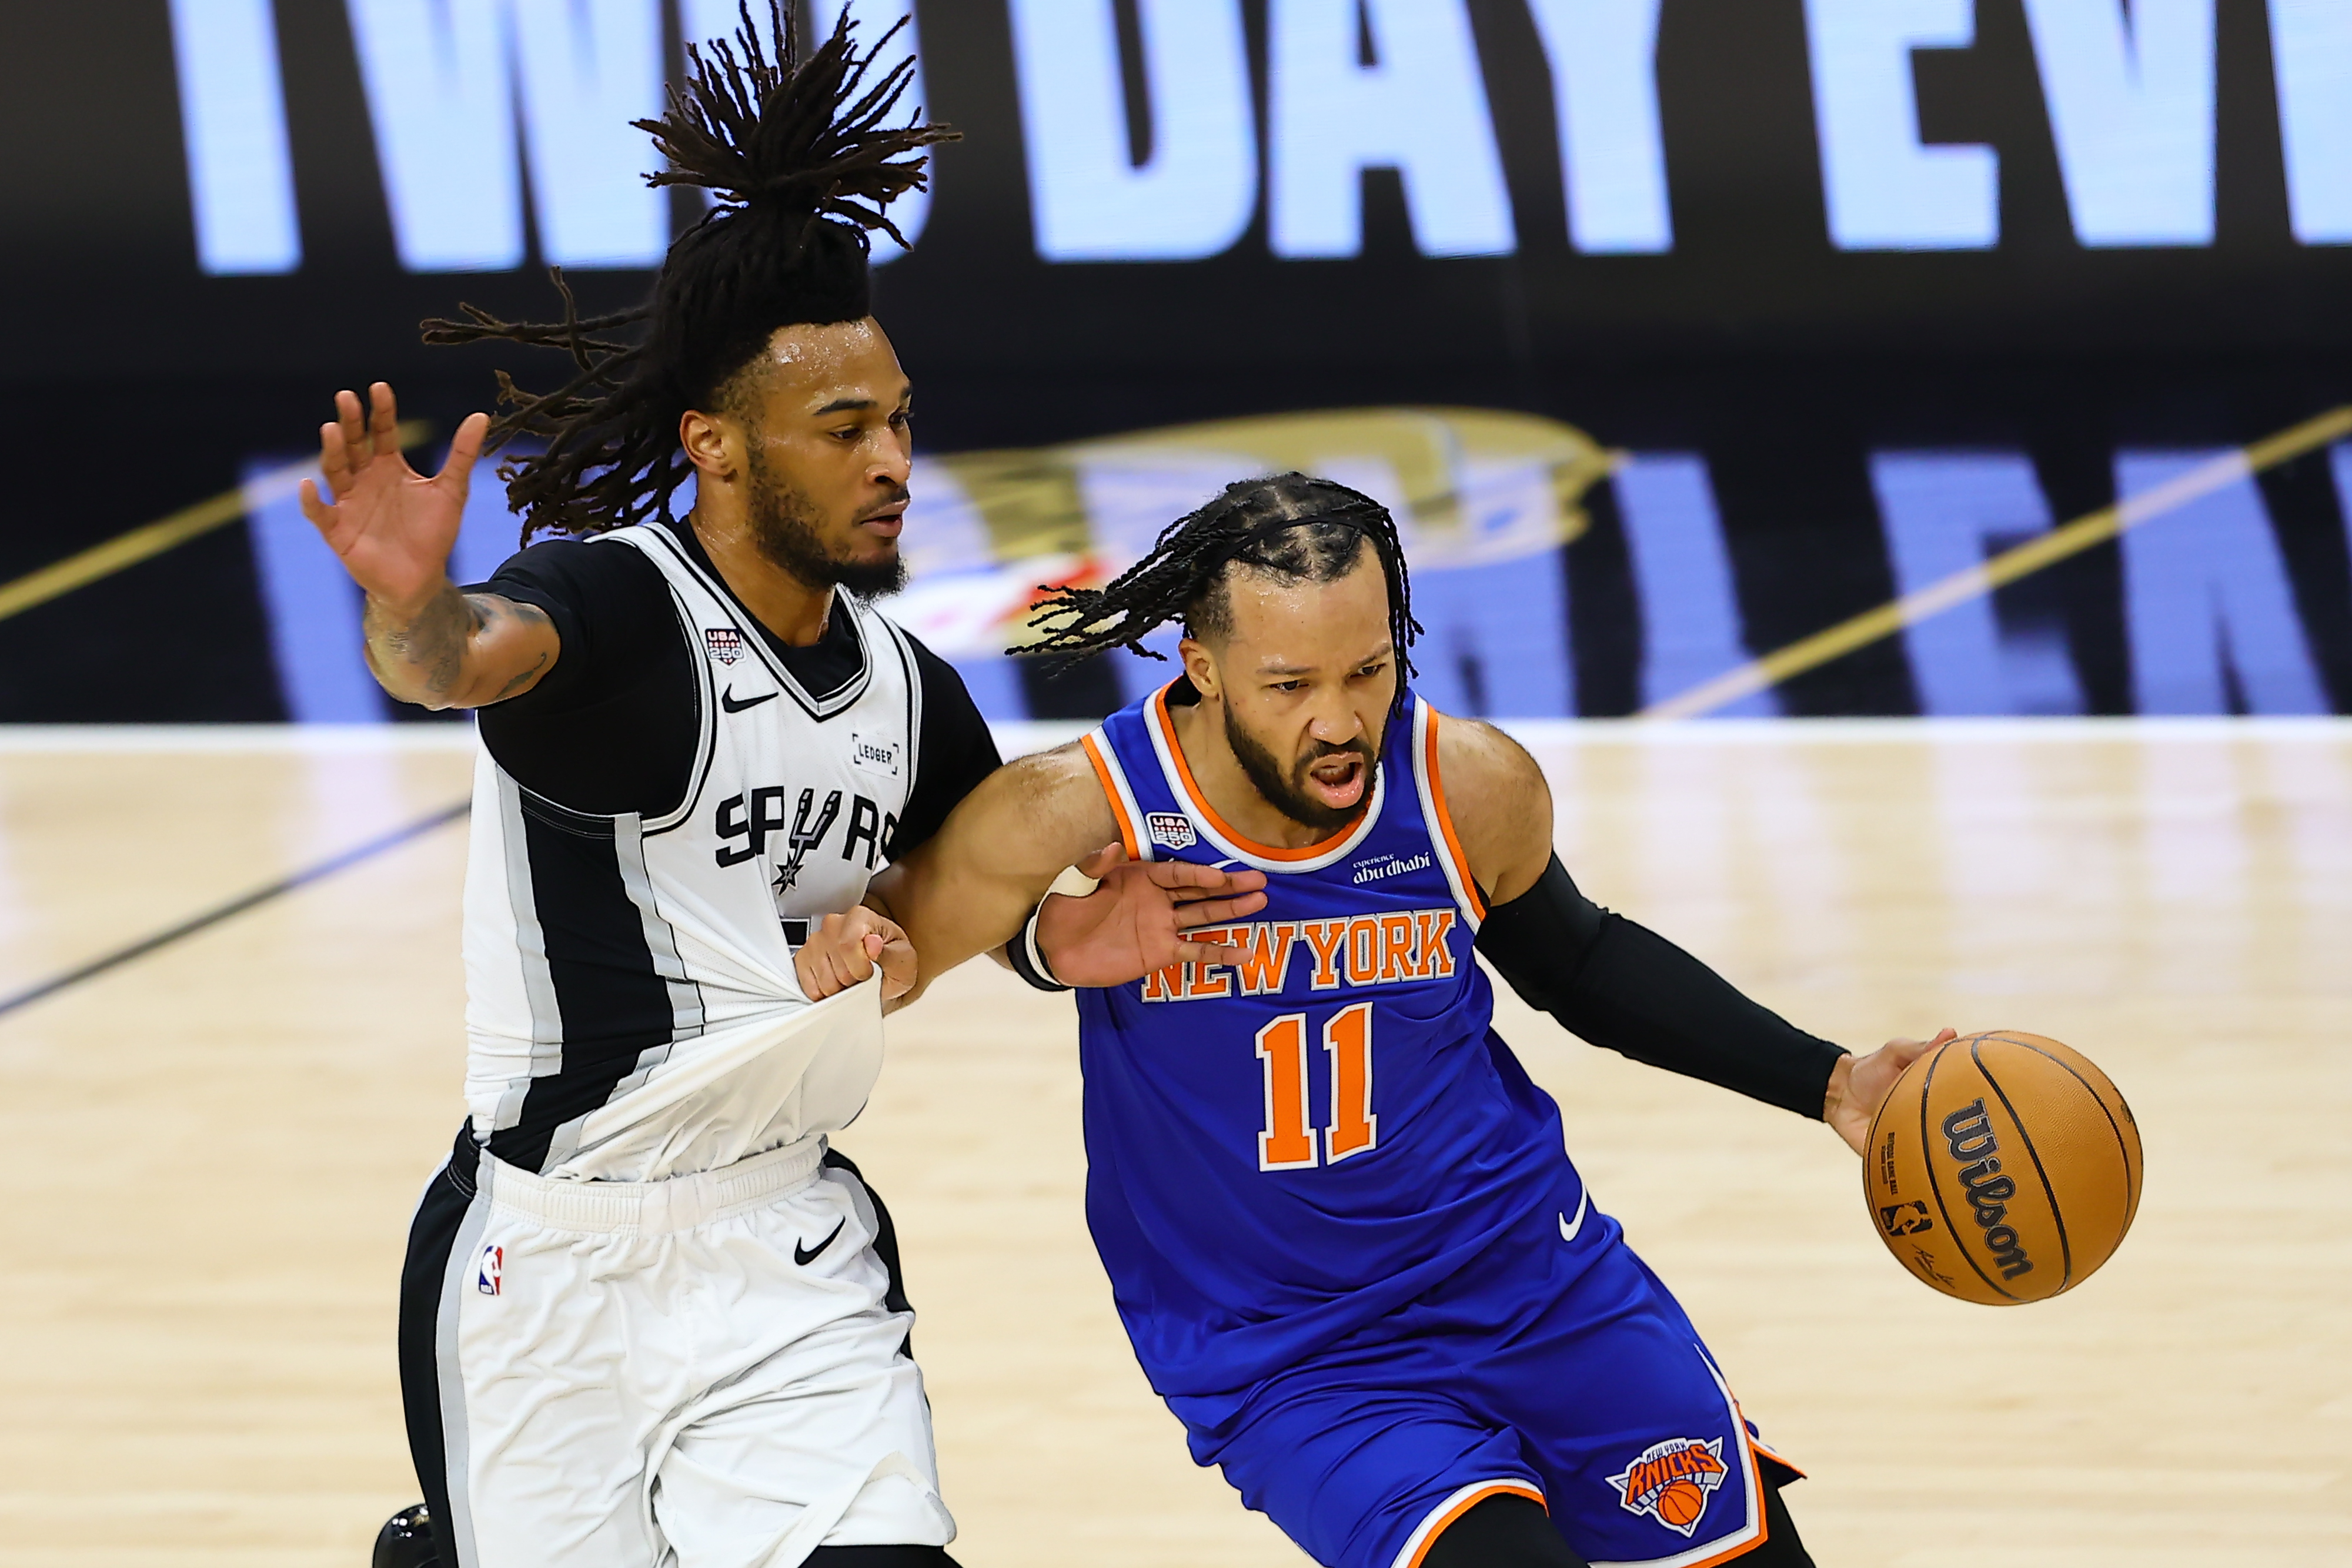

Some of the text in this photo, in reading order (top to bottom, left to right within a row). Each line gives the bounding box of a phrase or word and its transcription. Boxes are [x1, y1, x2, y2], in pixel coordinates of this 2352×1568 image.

[1803, 0, 2352, 252] EV
[707, 631, 739, 641] USA
[709, 647, 744, 658] 250
[858, 743, 892, 765] LEDGER
[1152, 817, 1188, 827] USA
[1155, 831, 1193, 841] 250
[1353, 853, 1394, 868] experience
[1354, 851, 1431, 884] abu dhabi
[1300, 908, 1456, 991] YORK
[1255, 1001, 1377, 1172] 11
[1941, 1097, 2034, 1282] Wilson
[1646, 1442, 1687, 1463] NEW YORK
[1626, 1444, 1725, 1505] KNICKS
